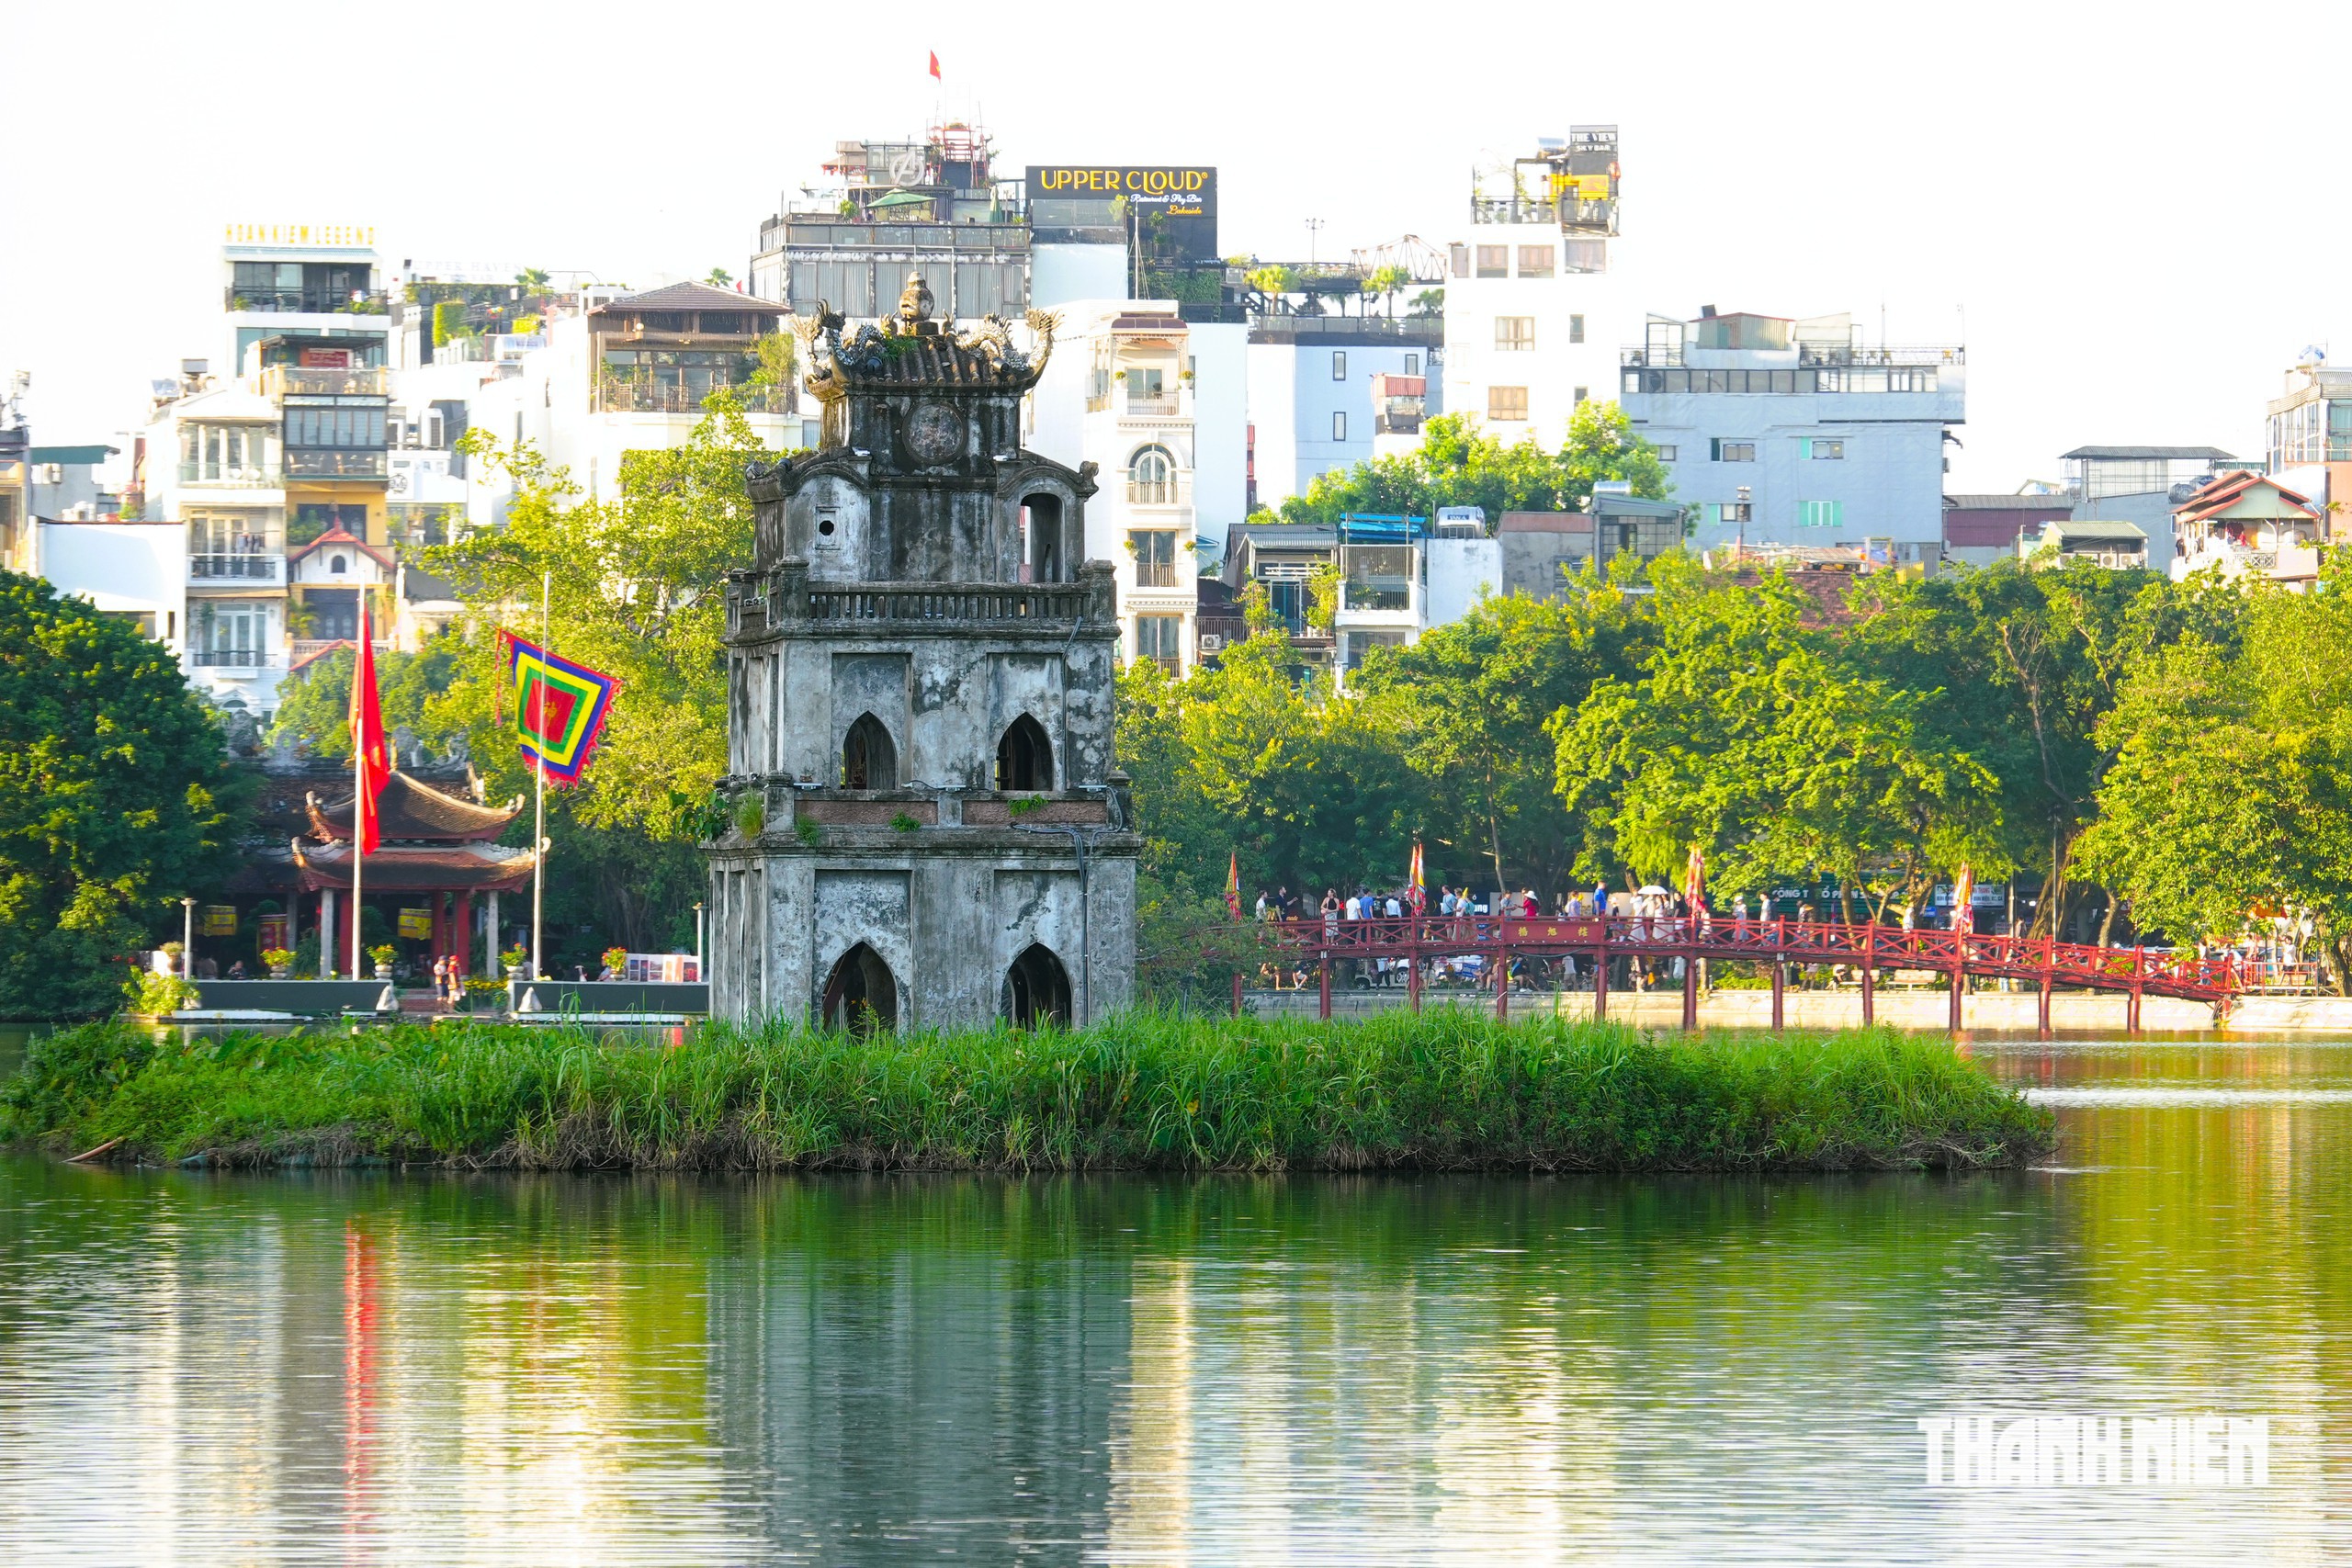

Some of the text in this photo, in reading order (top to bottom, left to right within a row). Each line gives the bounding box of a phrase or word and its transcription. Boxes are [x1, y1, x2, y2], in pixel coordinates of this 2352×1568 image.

[1571, 132, 1616, 141] THE VIEW
[1041, 170, 1120, 190] UPPER
[1186, 194, 1203, 203] Bar
[1166, 204, 1203, 215] Lakeside
[316, 226, 375, 245] LEGEND
